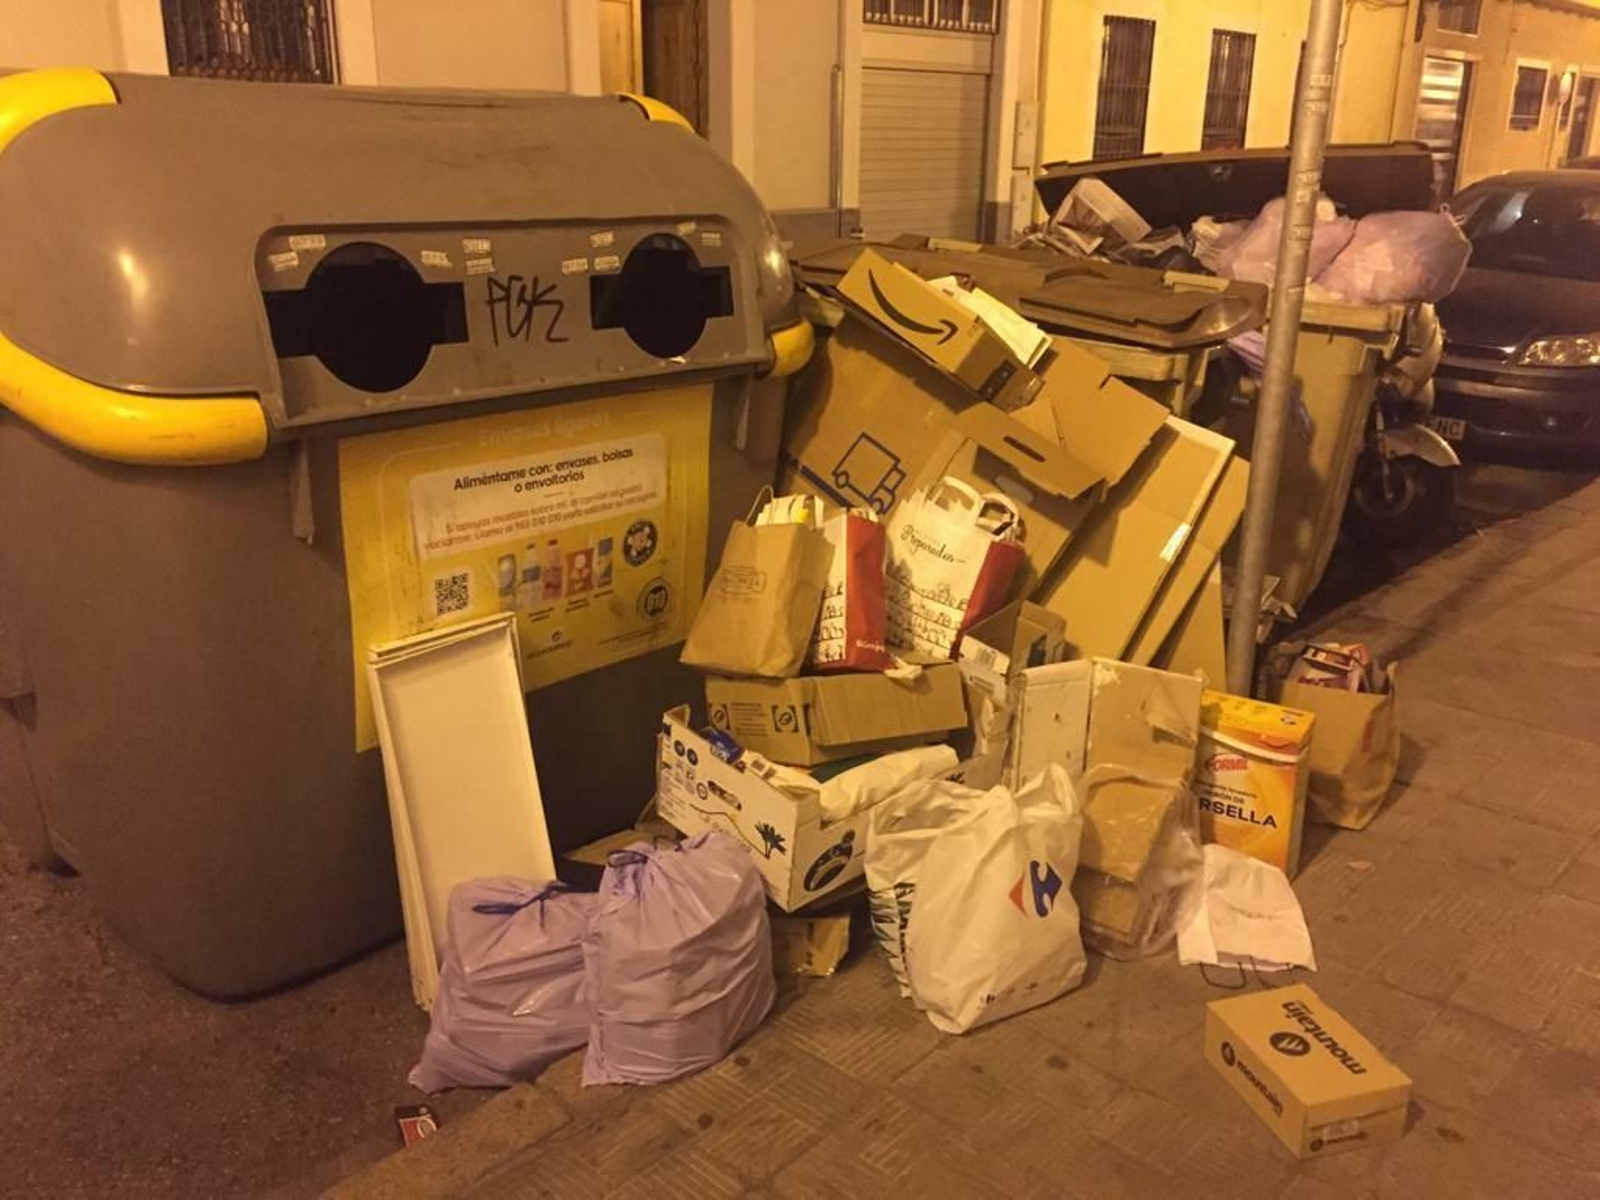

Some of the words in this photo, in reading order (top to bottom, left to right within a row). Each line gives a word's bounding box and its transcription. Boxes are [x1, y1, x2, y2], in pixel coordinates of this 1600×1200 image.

[602, 448, 634, 463] bolsas
[514, 482, 523, 493] o
[525, 470, 585, 491] envoltorios
[1199, 797, 1277, 829] RSELLA
[1280, 1001, 1368, 1076] mountain
[1235, 1060, 1284, 1118] mountain
